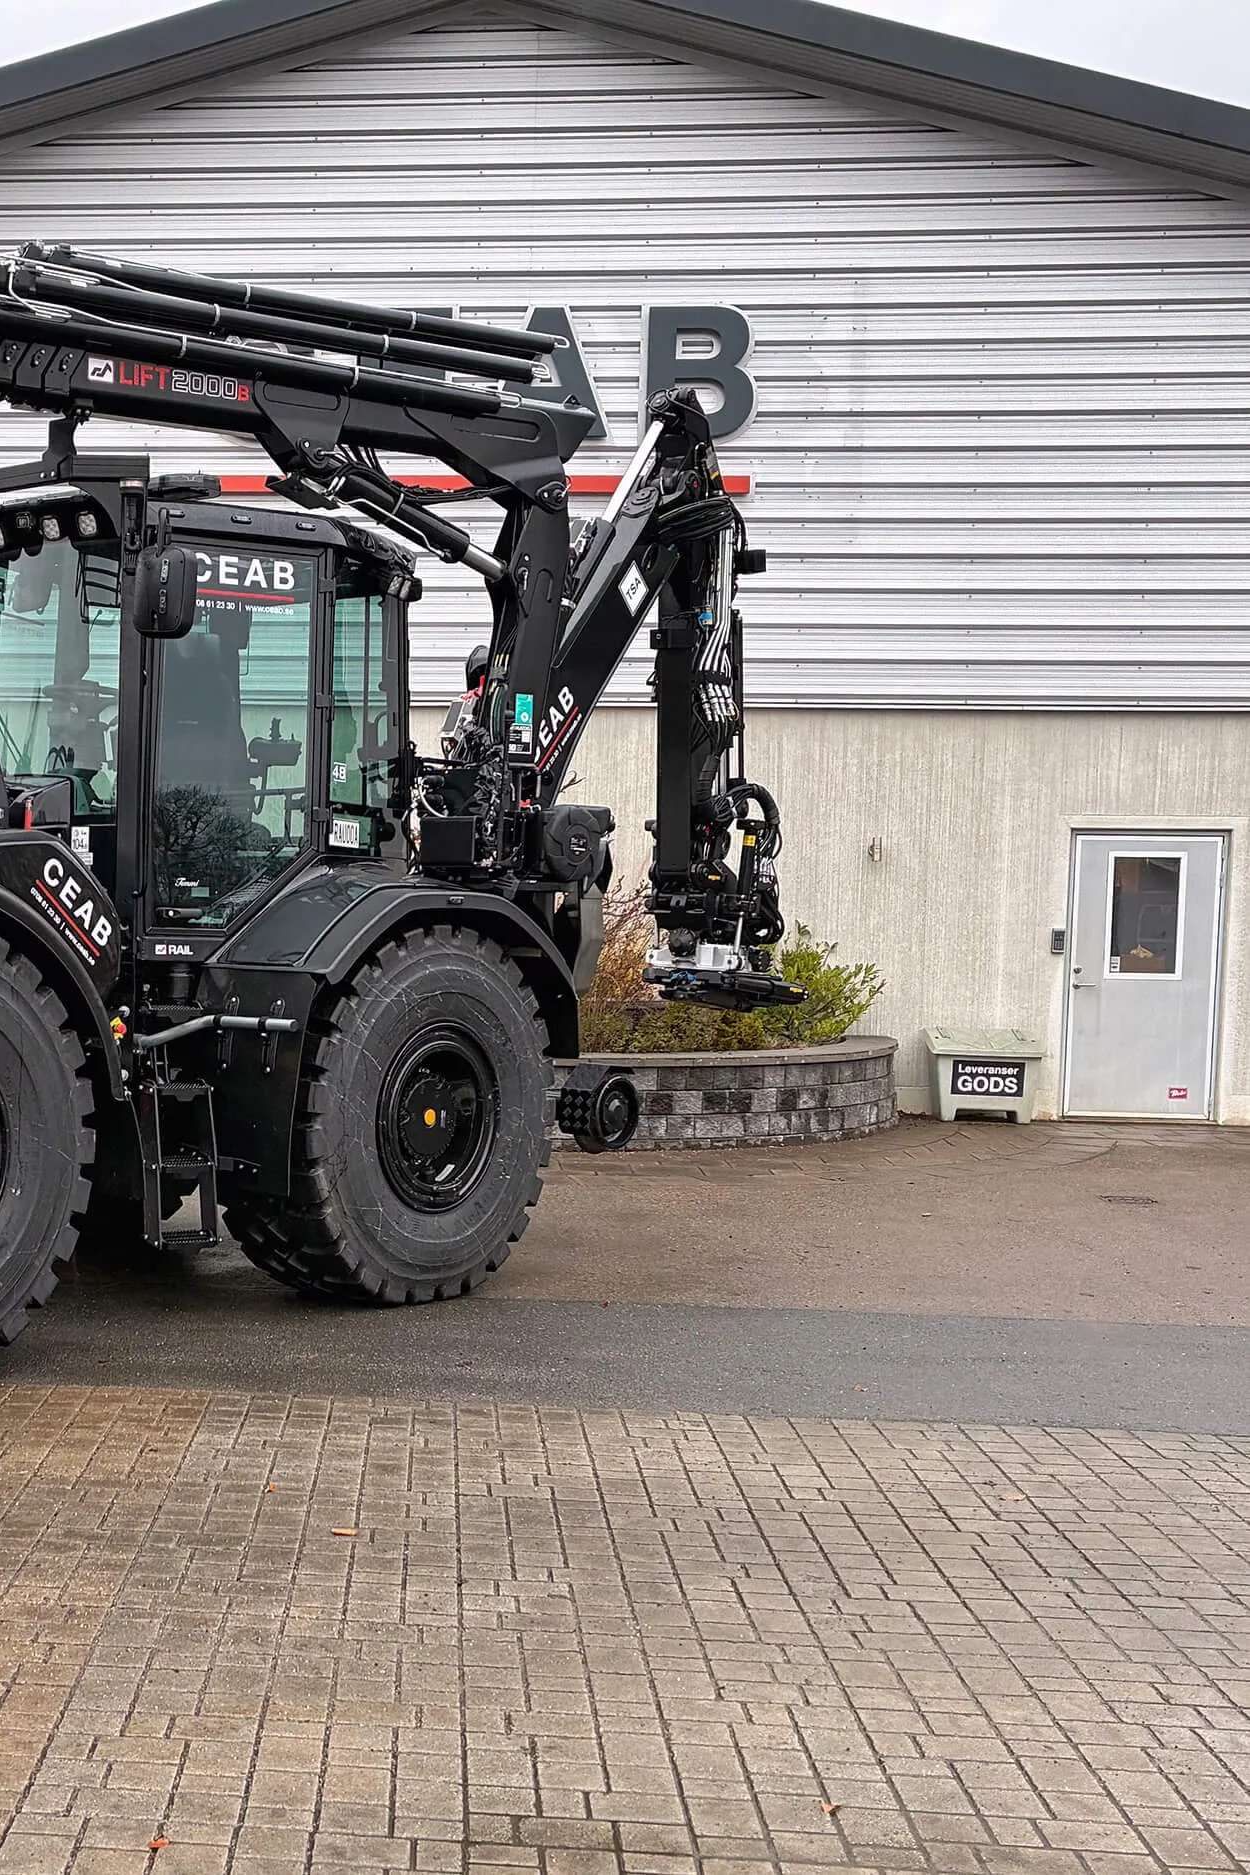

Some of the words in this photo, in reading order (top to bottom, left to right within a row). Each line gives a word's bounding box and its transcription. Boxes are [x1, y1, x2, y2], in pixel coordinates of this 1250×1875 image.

[195, 552, 295, 590] CEAB
[625, 576, 642, 601] TSA
[43, 858, 112, 947] CEAB
[168, 944, 194, 956] RAIL
[958, 1063, 1019, 1076] Leveranser
[957, 1076, 1019, 1094] GODS
